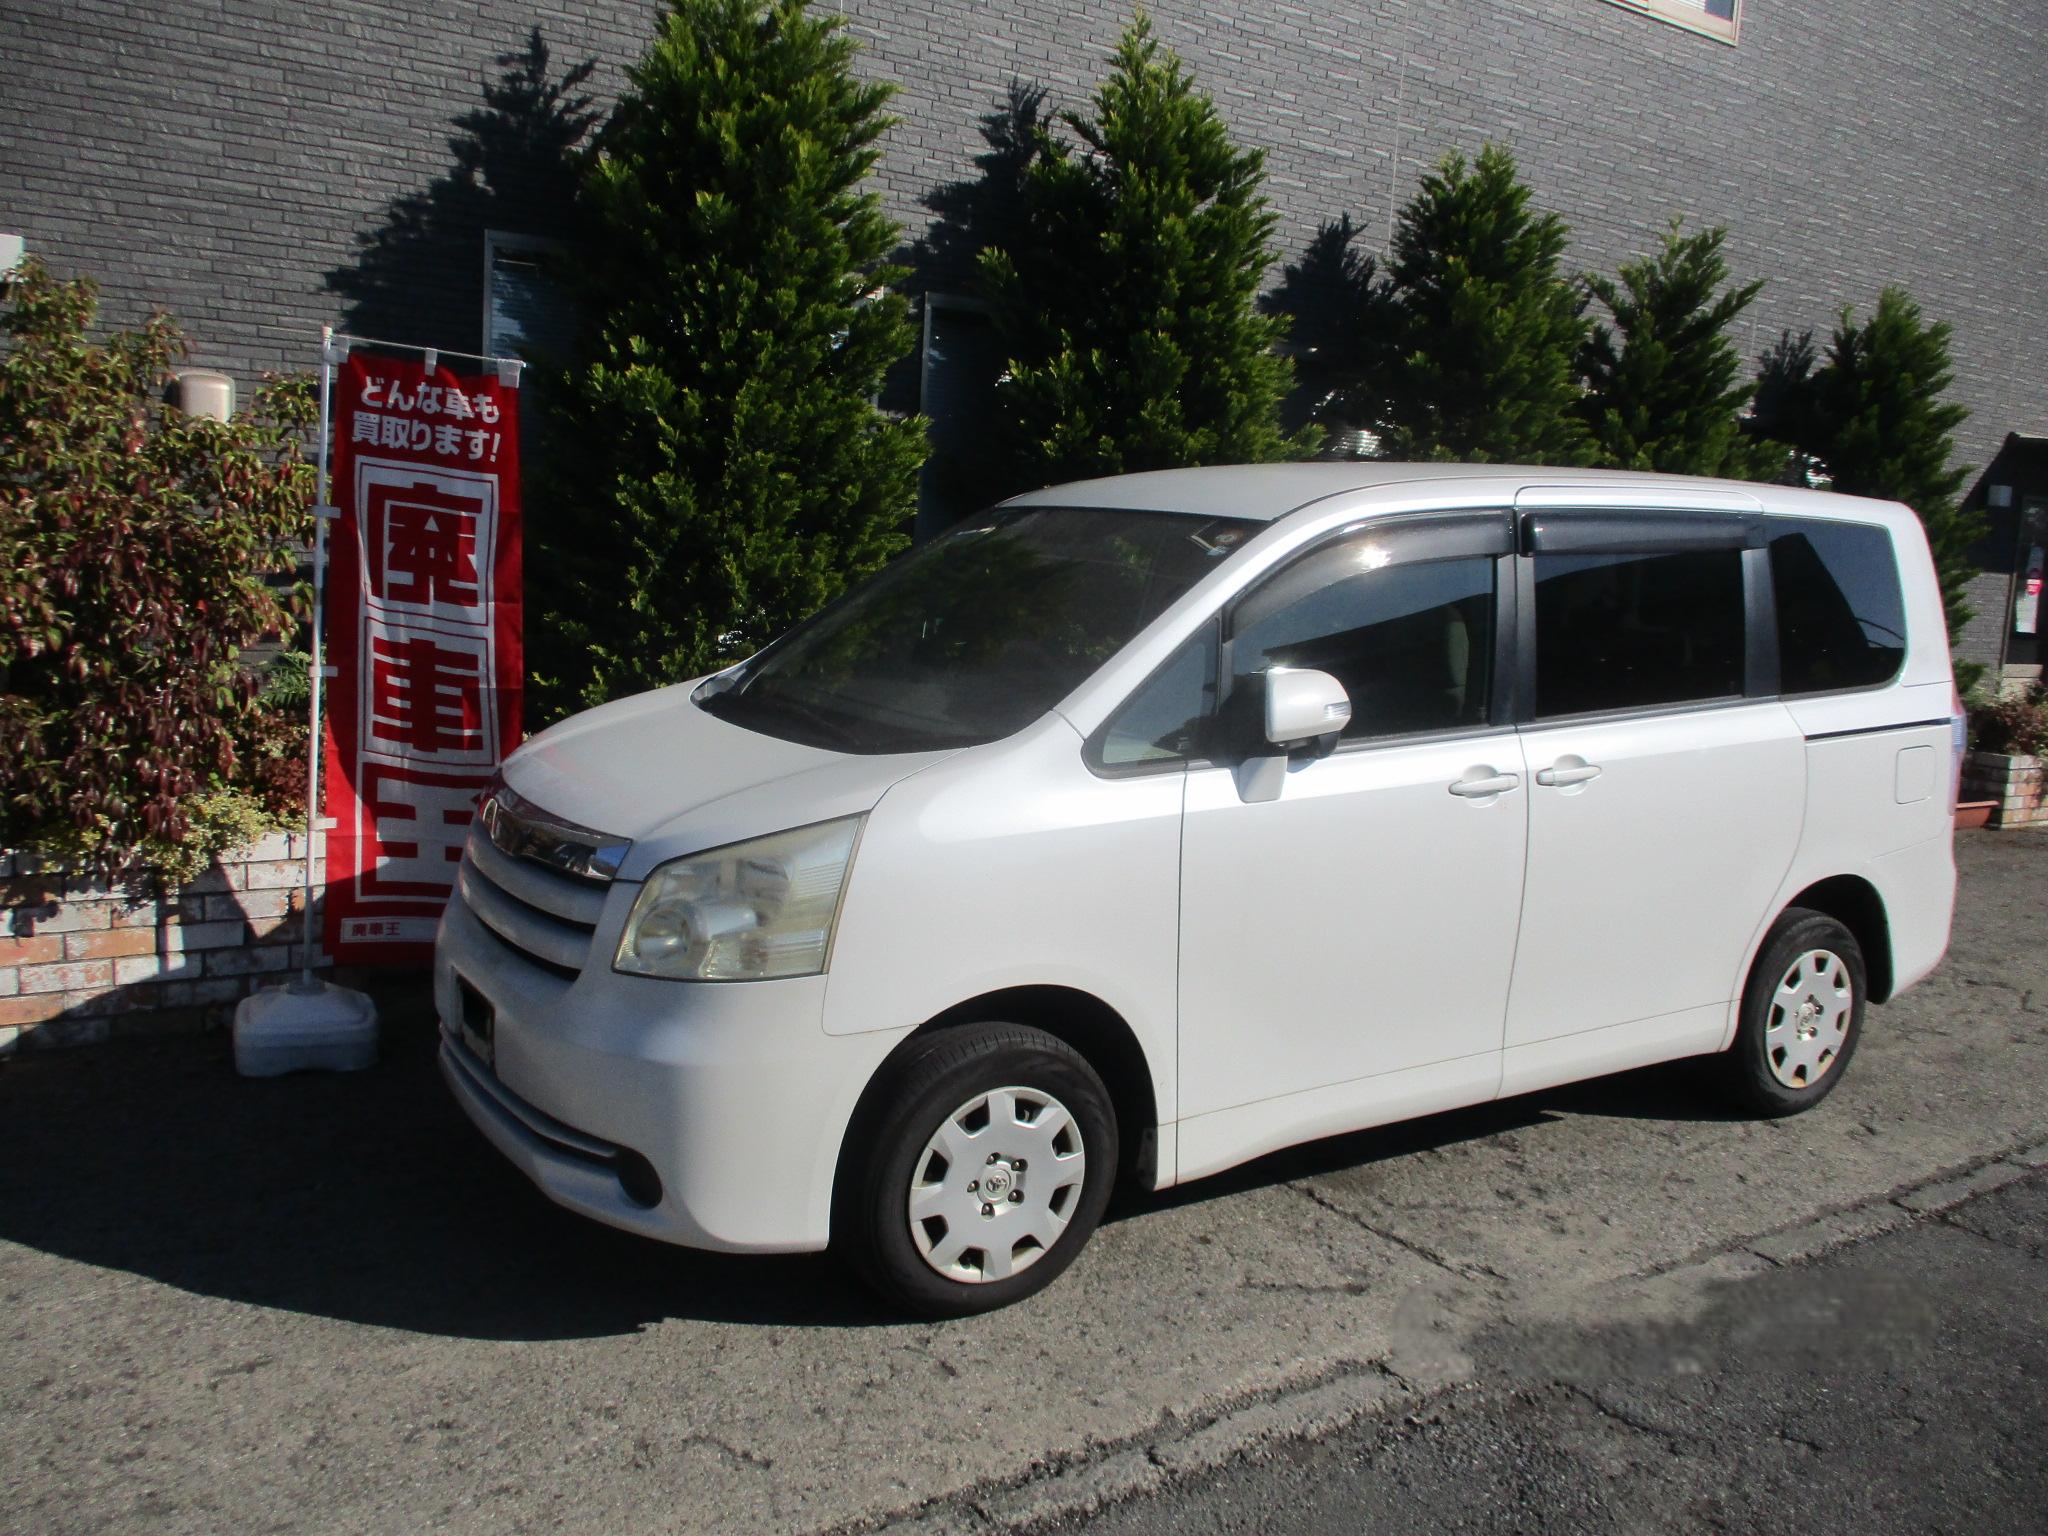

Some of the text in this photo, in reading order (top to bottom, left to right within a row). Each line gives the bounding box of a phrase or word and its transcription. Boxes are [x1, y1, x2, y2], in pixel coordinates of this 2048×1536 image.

[360, 375, 500, 423] どんな車も
[352, 410, 500, 462] 買取ります!
[367, 481, 485, 884] 廃車王
[351, 921, 401, 937] 廃車王
